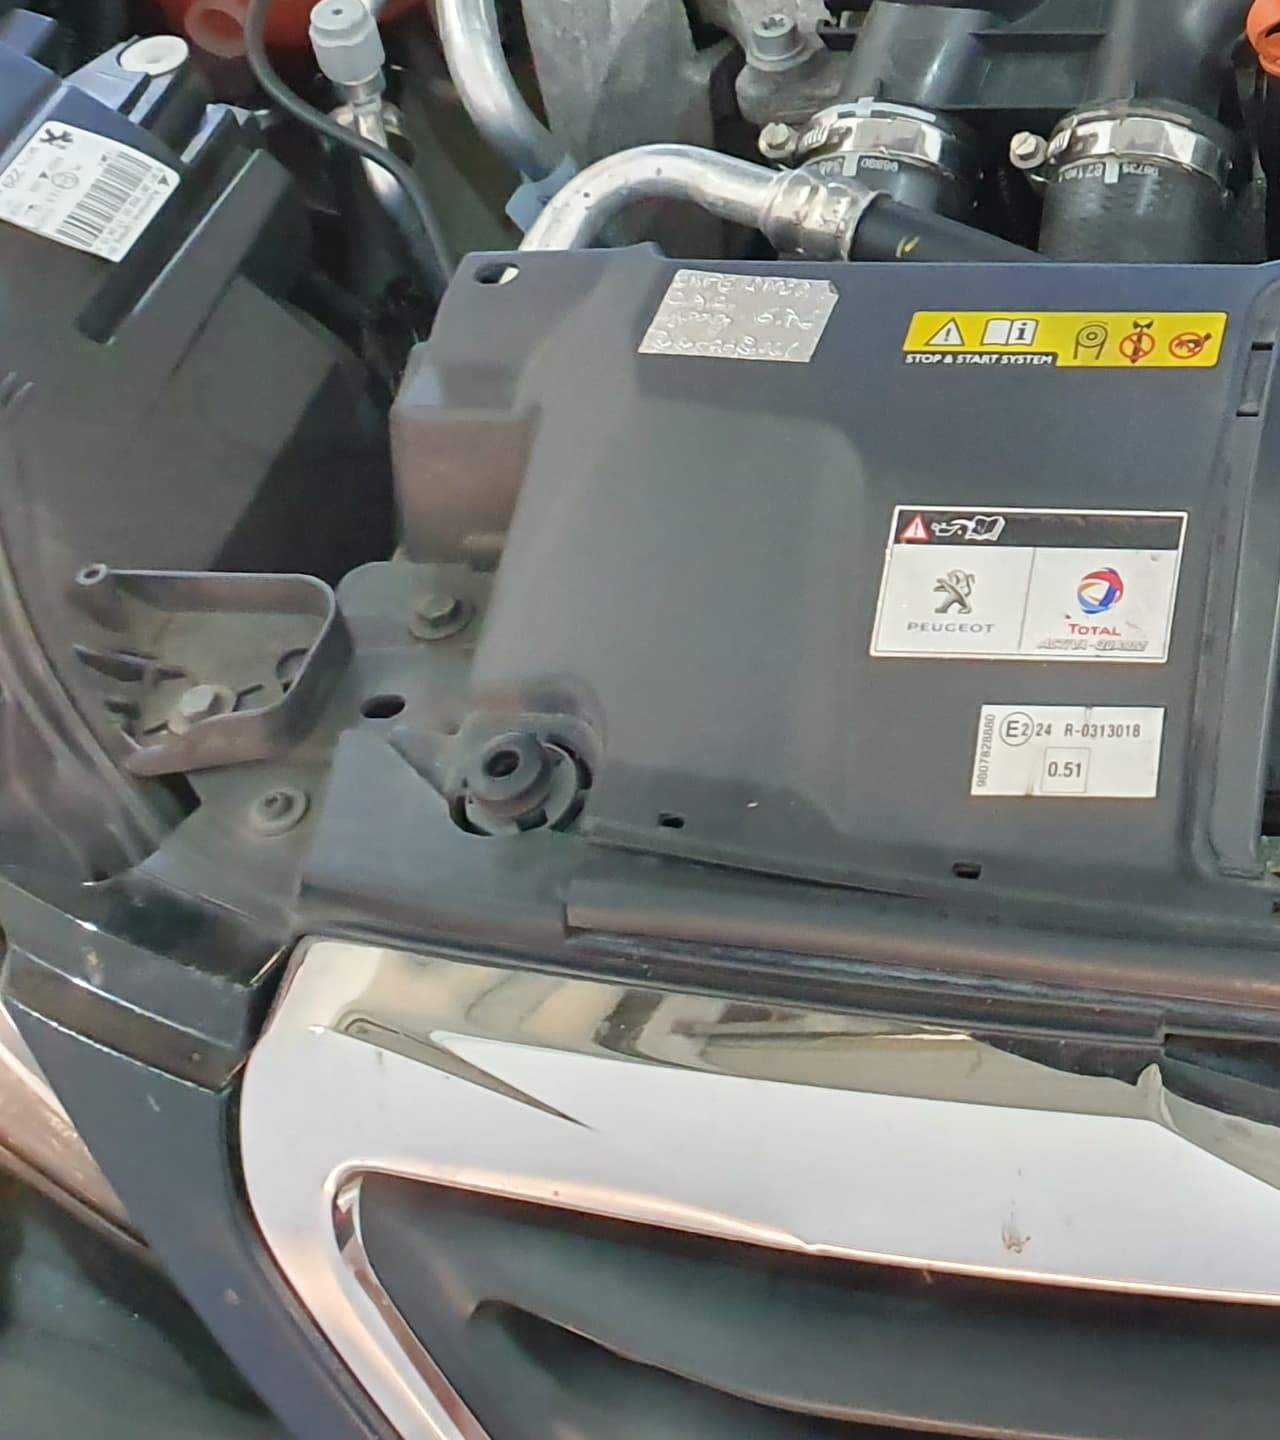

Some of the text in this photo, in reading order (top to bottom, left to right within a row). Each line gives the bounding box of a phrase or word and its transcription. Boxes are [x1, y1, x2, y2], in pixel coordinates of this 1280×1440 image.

[905, 354, 1054, 365] STOP & START SYSTEM
[907, 622, 996, 634] PEUGEOT
[1036, 723, 1052, 737] 24
[1064, 723, 1141, 738] R-0313018
[1047, 761, 1082, 778] 0.51
